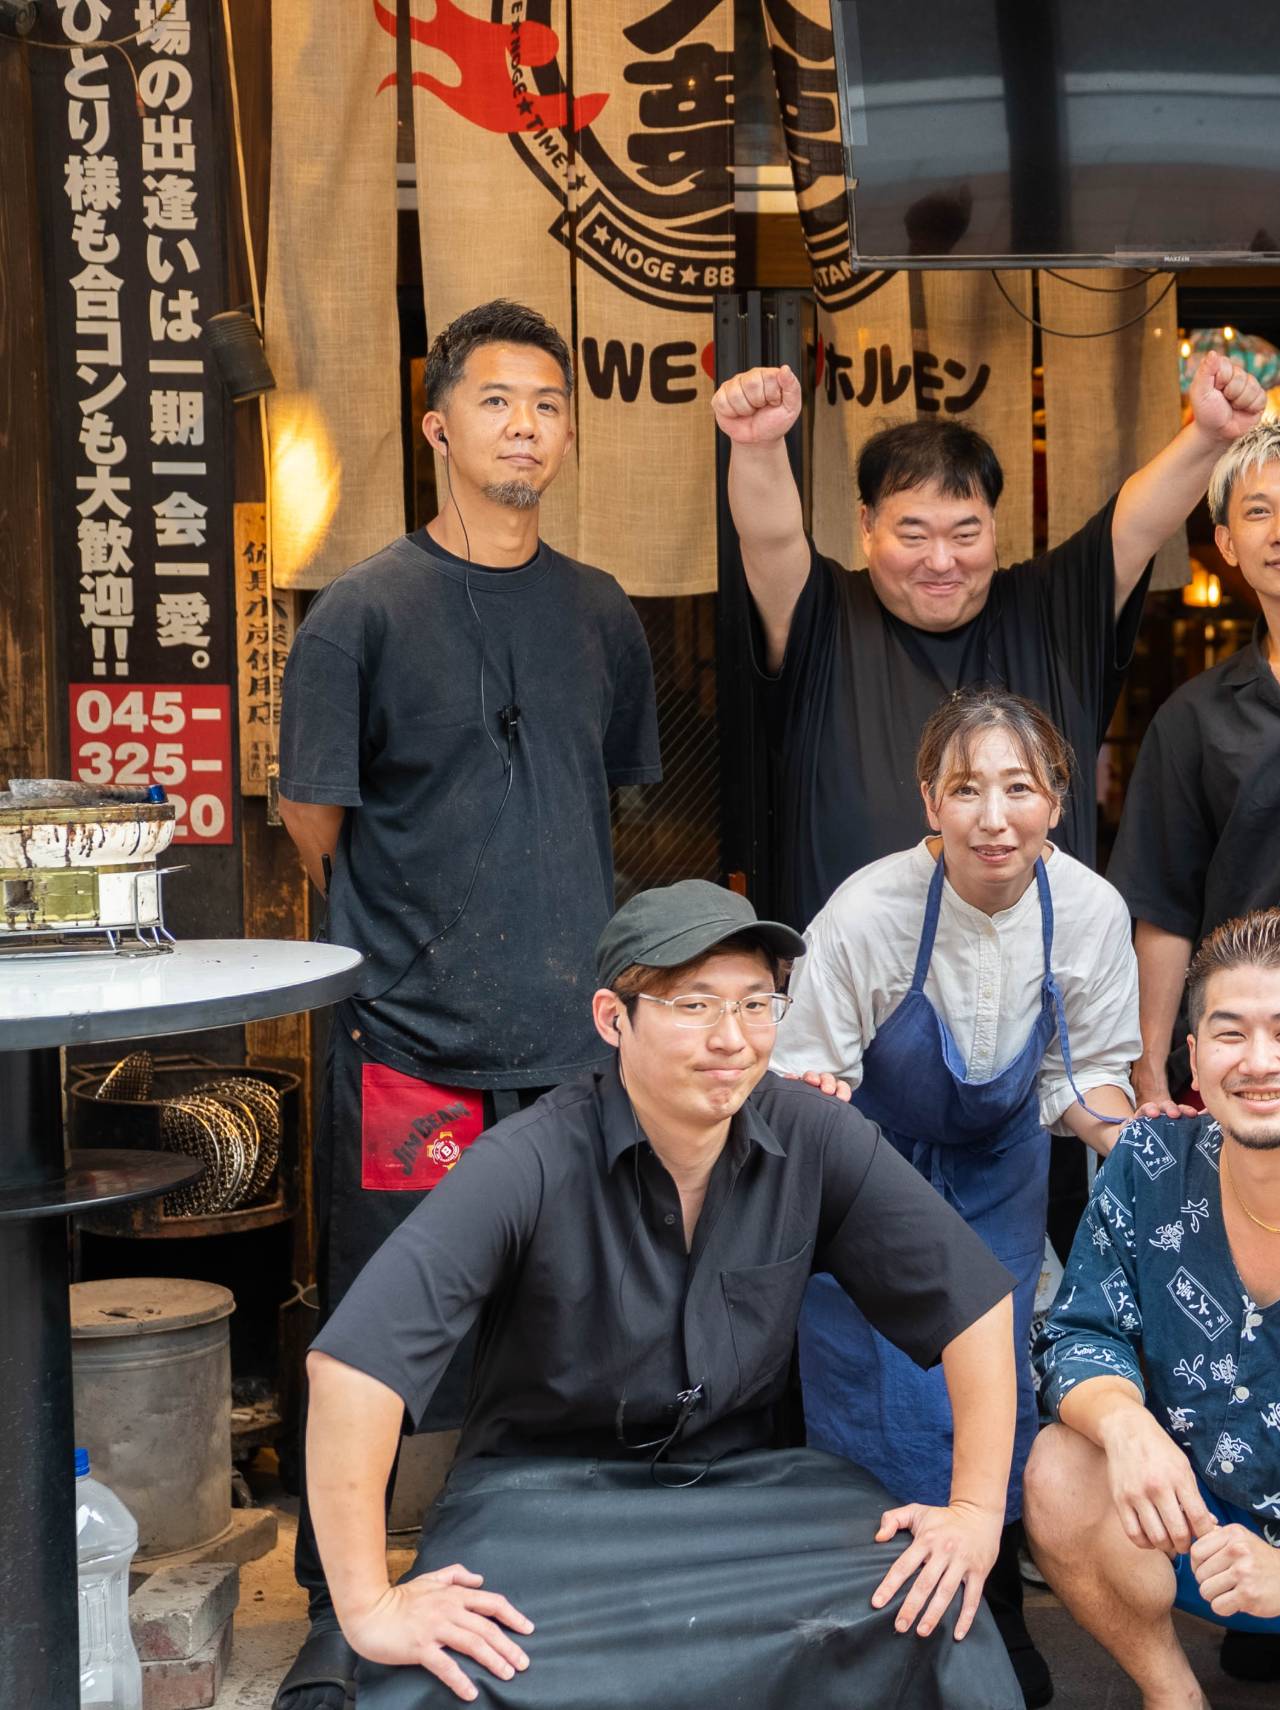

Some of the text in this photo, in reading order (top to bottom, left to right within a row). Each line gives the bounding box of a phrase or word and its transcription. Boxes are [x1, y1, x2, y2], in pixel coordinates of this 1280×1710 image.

[510, 36, 528, 99] NOGE
[526, 114, 569, 168] TIME
[611, 238, 676, 283] NOGE
[581, 336, 991, 413] WE ホルモン
[76, 690, 222, 735] 045-
[77, 743, 223, 787] 325-
[392, 1132, 424, 1177] JIM
[411, 1101, 472, 1140] BEAM
